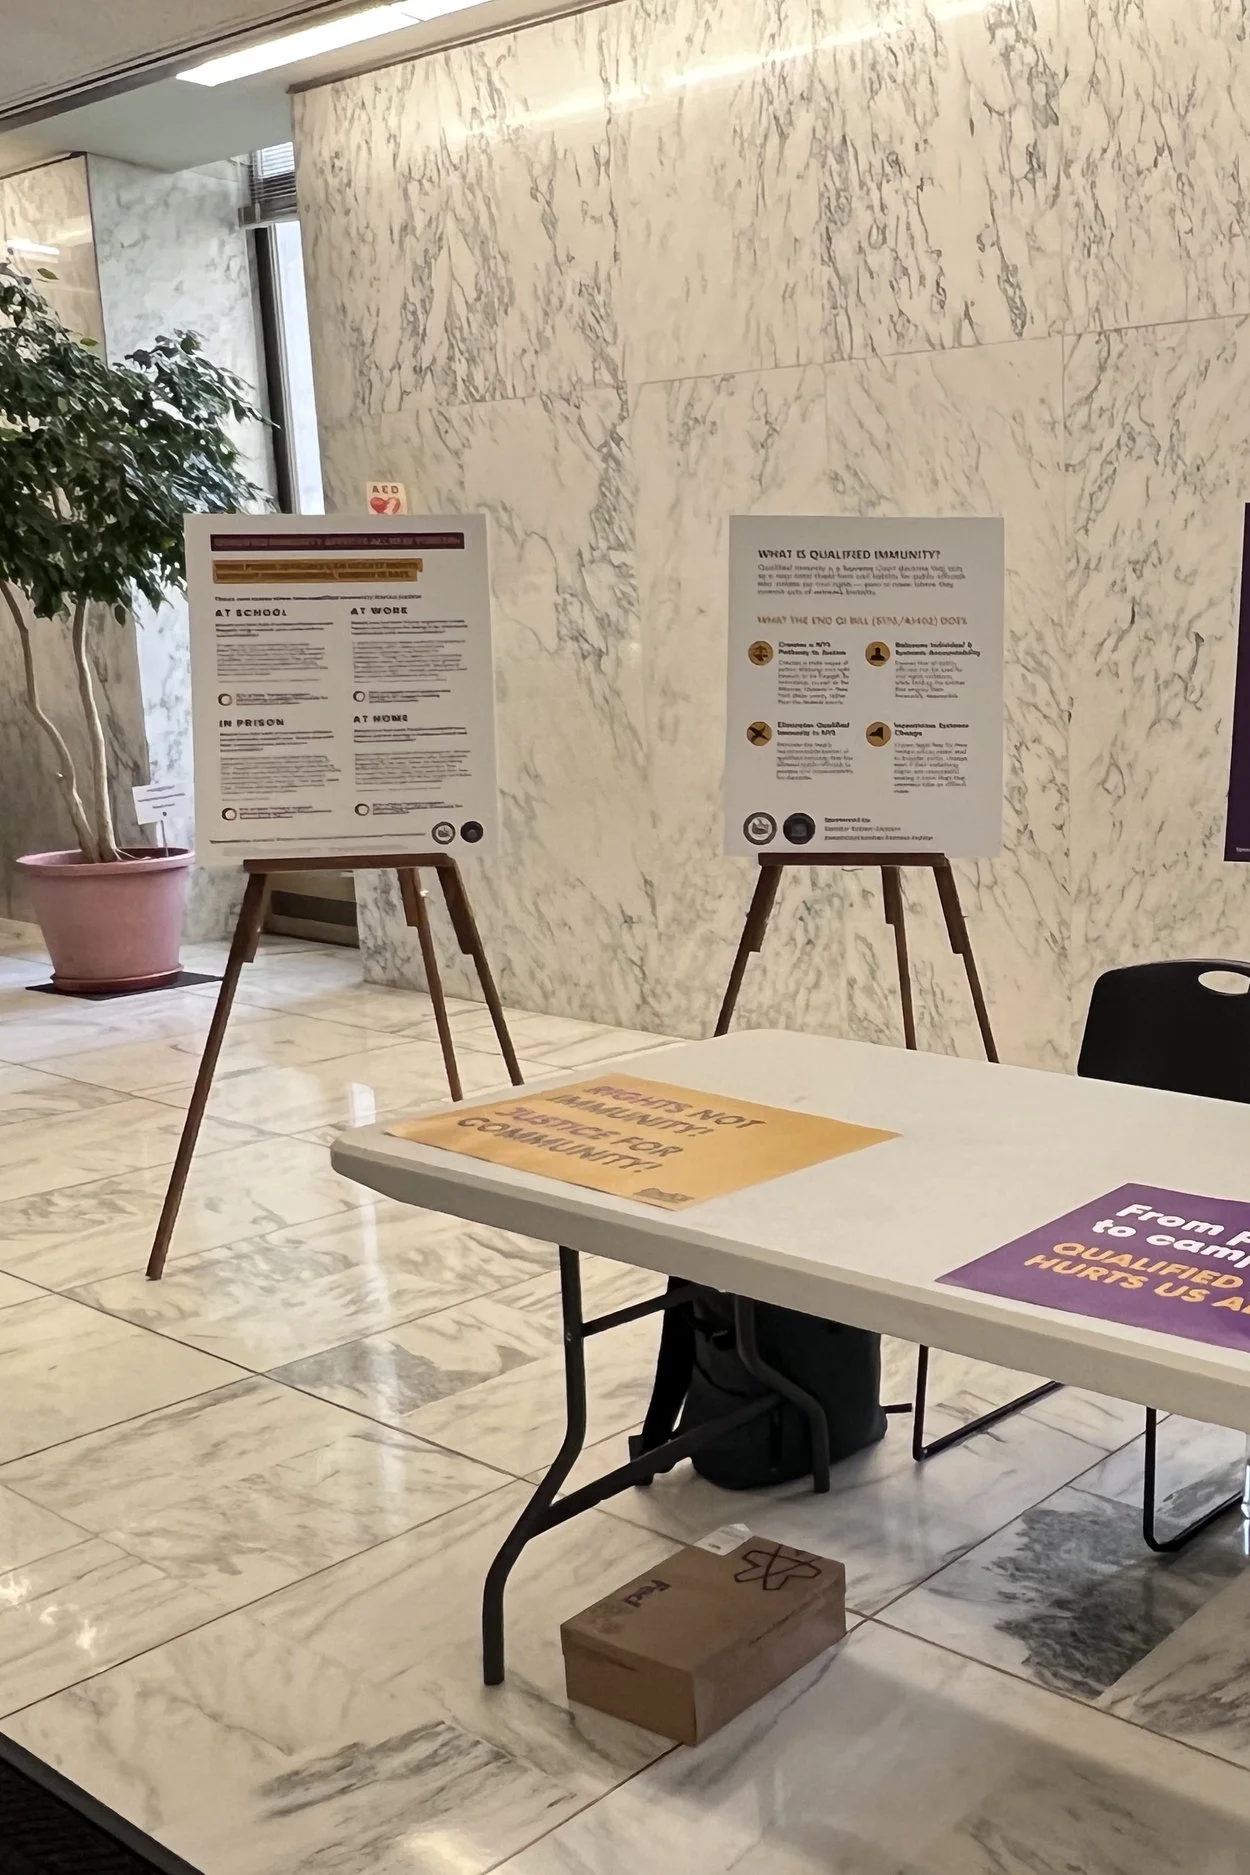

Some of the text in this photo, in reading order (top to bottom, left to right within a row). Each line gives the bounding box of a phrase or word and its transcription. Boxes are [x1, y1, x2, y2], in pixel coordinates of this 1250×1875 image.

[371, 485, 399, 494] AED
[757, 549, 942, 561] WHAT IS QUALIFIED IMMUNITY?
[214, 608, 288, 617] AT SCHOOL
[350, 606, 408, 615] AT WORK
[219, 718, 285, 728] IN PRISON
[353, 713, 408, 723] AT HOME
[546, 1094, 714, 1137] IMMUNITY!
[584, 1085, 768, 1129] RIGHTS NOT
[457, 1116, 663, 1173] COMMUNITY!
[495, 1106, 684, 1158] JUSTICE FOR
[1092, 1218, 1137, 1238] to
[1116, 1203, 1225, 1236] From
[1023, 1254, 1149, 1290] HURTS
[1154, 1281, 1211, 1303] US
[1052, 1242, 1244, 1289] QUALIFIED
